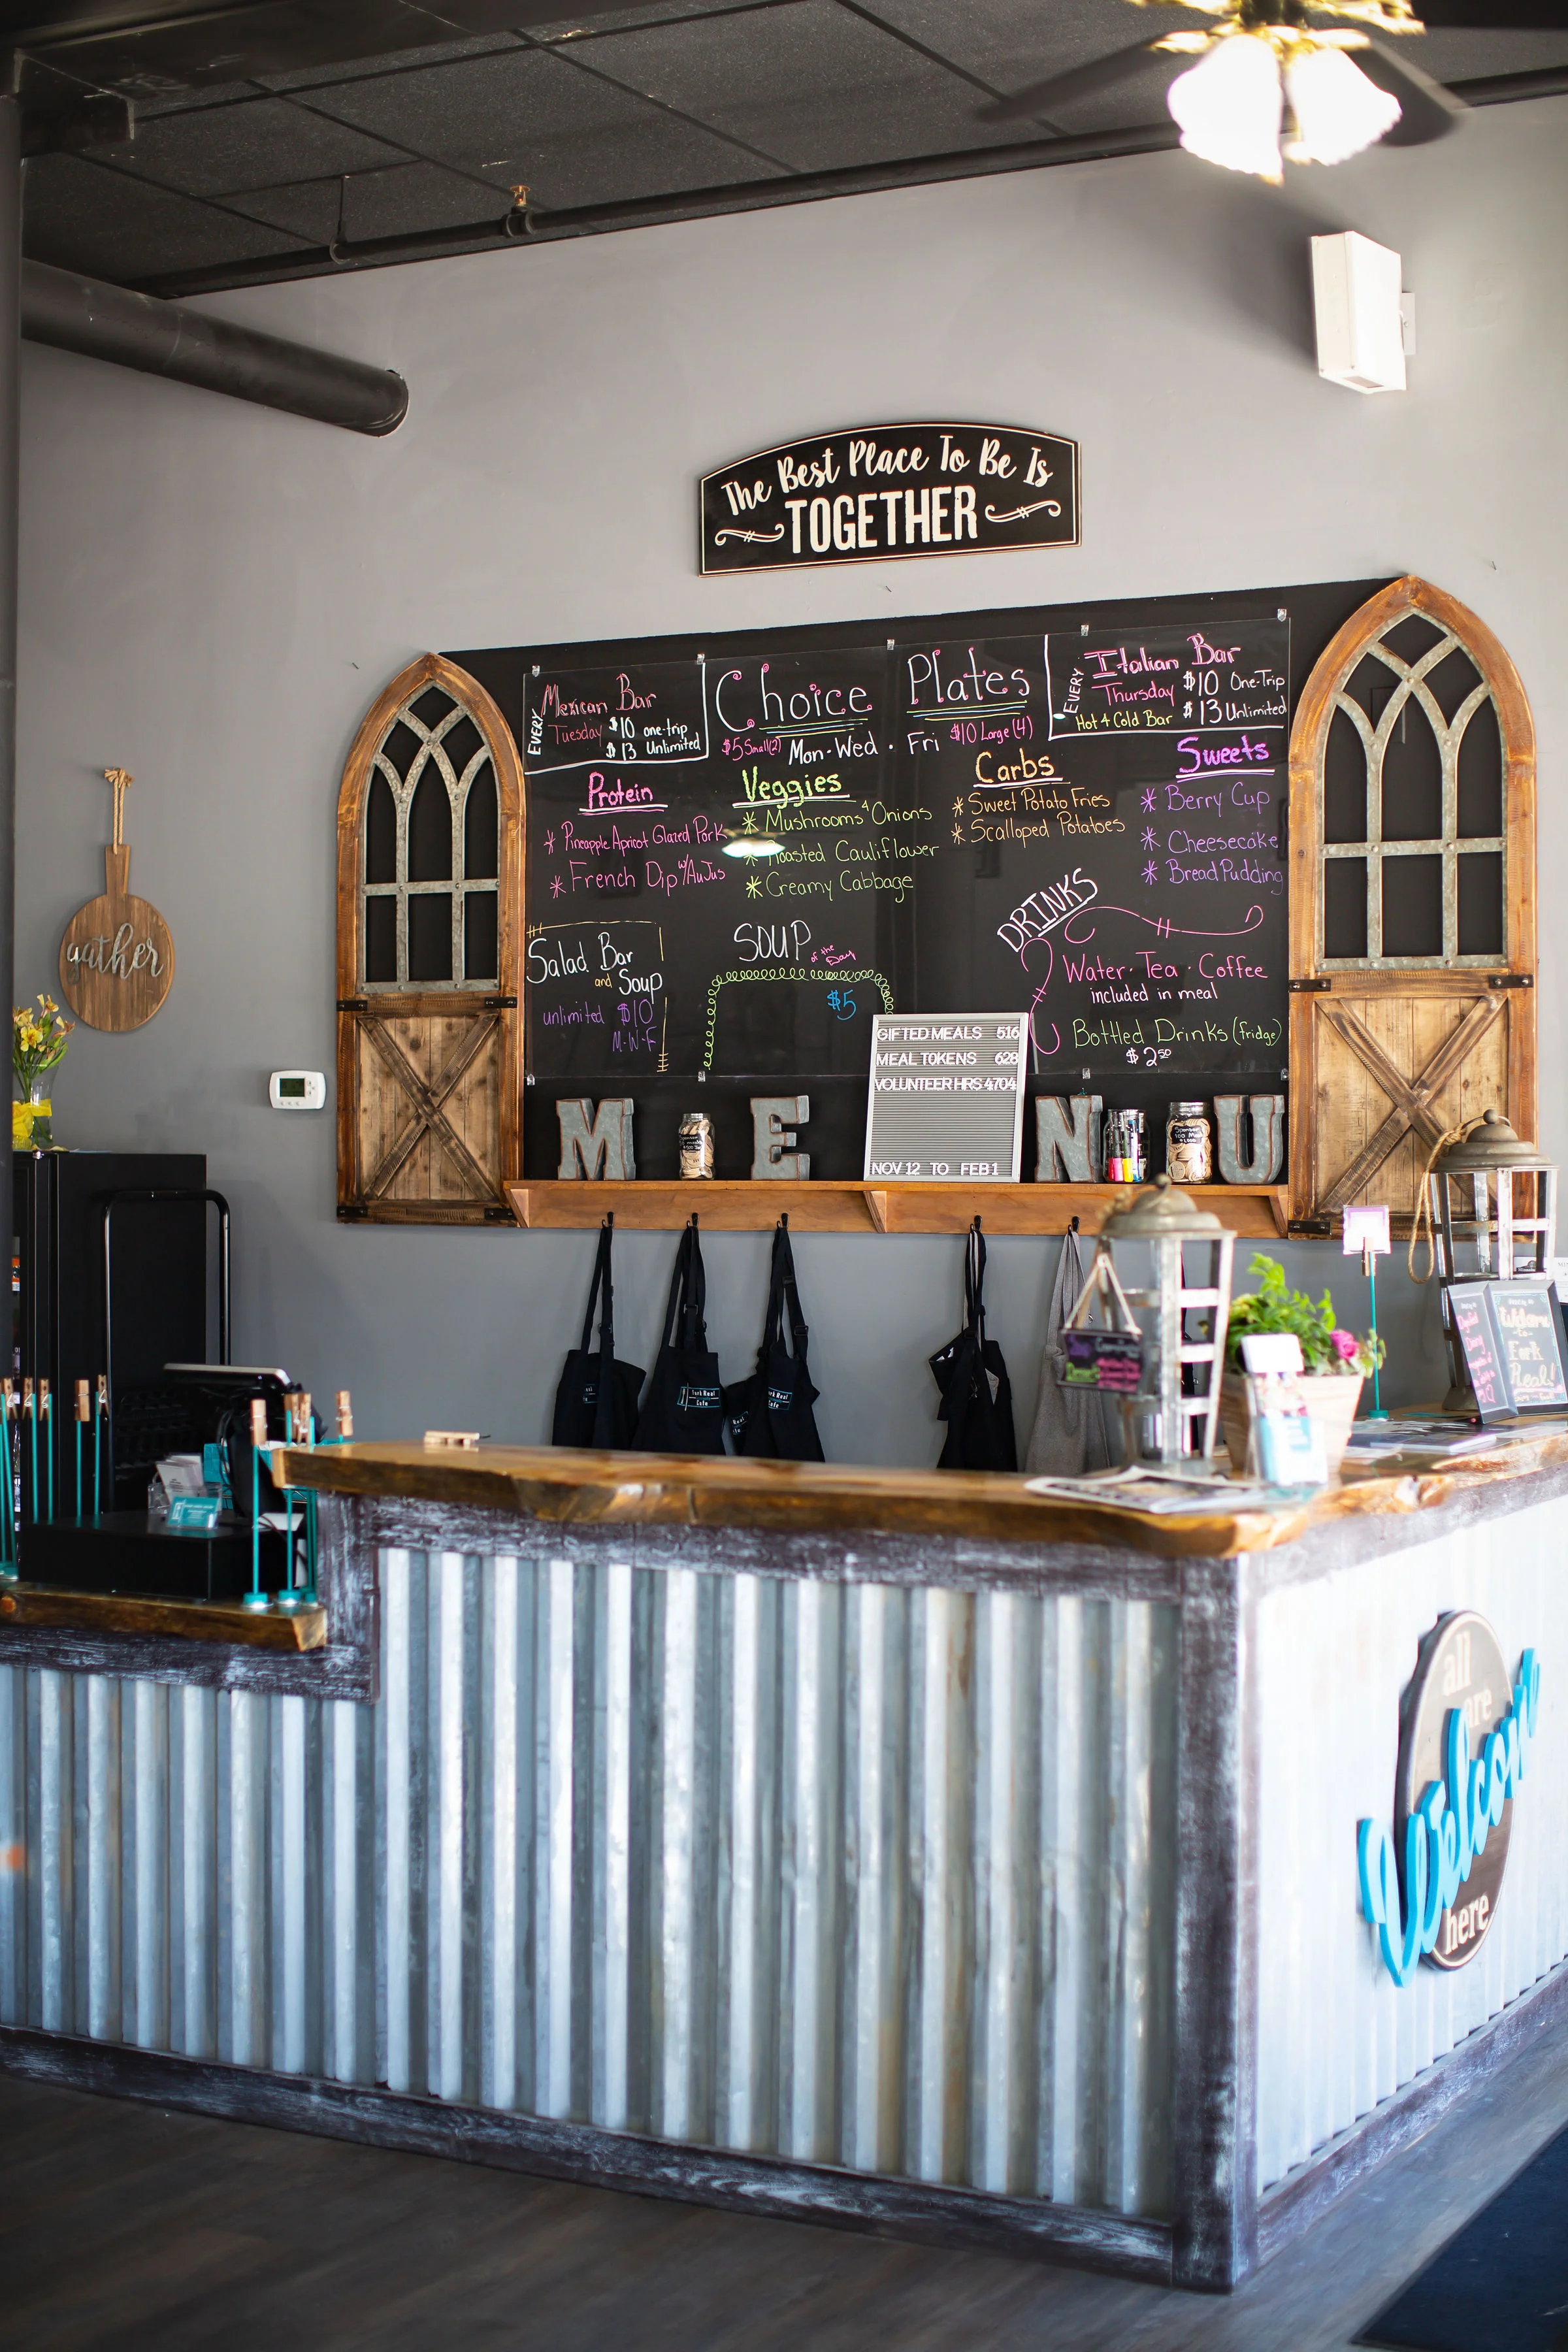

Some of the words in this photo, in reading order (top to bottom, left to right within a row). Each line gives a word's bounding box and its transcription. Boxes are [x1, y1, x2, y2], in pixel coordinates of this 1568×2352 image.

[721, 480, 772, 516] The
[777, 448, 840, 493] Best
[849, 440, 930, 476] Place
[939, 435, 970, 472] To
[979, 438, 1017, 478] Be
[1023, 447, 1053, 487] Is
[785, 485, 977, 553] TOGETHER
[1084, 647, 1179, 679] Italian
[1187, 633, 1241, 666] Bar
[541, 684, 608, 717] Mexican
[616, 673, 656, 711] Bar
[716, 663, 872, 732] Choice
[907, 647, 1030, 705] Plates
[1063, 668, 1085, 714] EVERY
[1092, 681, 1175, 707] Thursday
[1183, 670, 1219, 696] $10
[1230, 670, 1284, 691] One-Trip
[1076, 715, 1098, 731] Hot
[1114, 710, 1139, 727] Cold
[1143, 710, 1173, 726] Bar
[1226, 696, 1287, 722] Unlimited
[527, 708, 544, 755] EVERY
[548, 722, 602, 747] Tuesday
[609, 716, 635, 739] $10
[644, 718, 688, 738] one-trip
[647, 732, 701, 754] Unlimited
[721, 737, 743, 760] $5
[907, 732, 939, 755] Fri
[950, 723, 977, 745] $10
[981, 721, 1009, 744] Large
[975, 748, 1054, 783] Carbs
[1177, 734, 1269, 773] Sweets
[589, 772, 653, 809] Protein
[742, 766, 841, 809] Veggies
[968, 792, 1017, 815] Sweet
[1021, 787, 1068, 811] Potato
[1071, 787, 1110, 808] Fries
[1165, 785, 1222, 817] Berry
[1232, 781, 1270, 814] Cup
[766, 809, 863, 832] Mushrooms
[872, 801, 932, 825] Onions
[971, 817, 1049, 849] Scalloped
[1057, 811, 1125, 836] Potatoes
[561, 821, 610, 856] Pineapple
[613, 825, 648, 857] Apricot
[653, 824, 690, 844] Glazed
[693, 815, 727, 844] Pork
[836, 837, 939, 862] Cauliflower
[1168, 830, 1279, 854] Cheesecake
[570, 860, 635, 892] French
[645, 861, 678, 896] Dip
[766, 872, 833, 901] Creamy
[840, 870, 914, 903] Cabbage
[1166, 858, 1218, 884] Bread
[1220, 858, 1283, 895] Pudding
[997, 868, 1098, 952] DRINKS
[67, 922, 163, 985] gather
[527, 938, 589, 983] Salad
[598, 932, 633, 970] Bar
[734, 920, 811, 962] SOUP
[811, 952, 818, 962] of
[821, 945, 834, 956] the
[826, 950, 857, 966] Day
[1062, 953, 1129, 983] Water
[1135, 951, 1177, 978] Tea
[1199, 953, 1268, 979] Coffee
[595, 973, 612, 988] and
[619, 968, 662, 1004] Soup
[1090, 984, 1149, 1004] included
[1158, 988, 1172, 1000] in
[1178, 982, 1218, 1000] meal
[543, 1001, 604, 1026] unlimited
[617, 999, 653, 1027] $10
[827, 990, 857, 1021] $5
[877, 1027, 929, 1041] GIFTED
[931, 1026, 982, 1040] MEALS
[996, 1026, 1020, 1039] 516
[1073, 1019, 1144, 1048] Bottled
[1155, 1019, 1228, 1043] Drinks
[1233, 1016, 1281, 1046] (fridge)
[875, 1052, 917, 1066] MEAL
[920, 1052, 977, 1066] TOKENS
[994, 1052, 1019, 1066] 628
[874, 1077, 953, 1091] VOLUNTEER
[954, 1077, 982, 1090] HRS
[984, 1077, 1017, 1091] 4704
[872, 1162, 902, 1175] NOV
[906, 1162, 920, 1175] 12
[930, 1163, 949, 1175] TO
[960, 1163, 988, 1175] FEB
[992, 1163, 998, 1175] 1
[1443, 1631, 1471, 1696] all
[1357, 1648, 1539, 1988] Welcome
[1445, 1891, 1490, 1956] here
